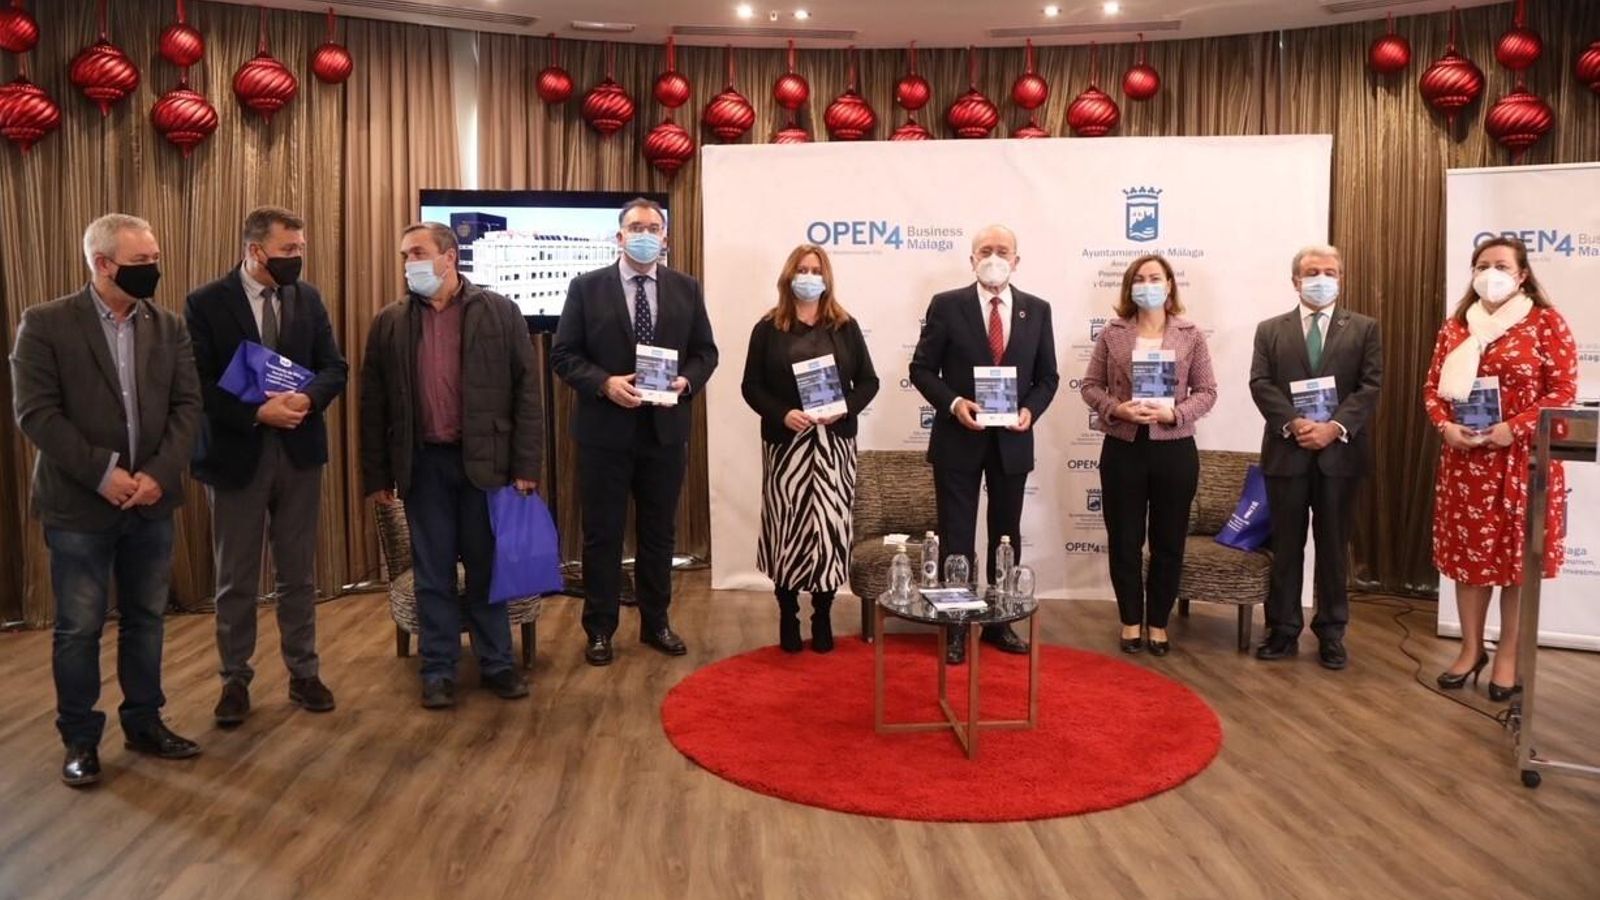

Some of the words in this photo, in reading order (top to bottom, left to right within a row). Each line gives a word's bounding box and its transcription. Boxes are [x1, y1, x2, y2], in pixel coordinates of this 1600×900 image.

[806, 220, 904, 250] OPEN4
[907, 226, 964, 237] Business
[907, 237, 954, 251] Málaga
[1082, 248, 1151, 258] Ayuntamiento
[1167, 247, 1204, 258] Málaga
[1065, 542, 1100, 553] OPEN4
